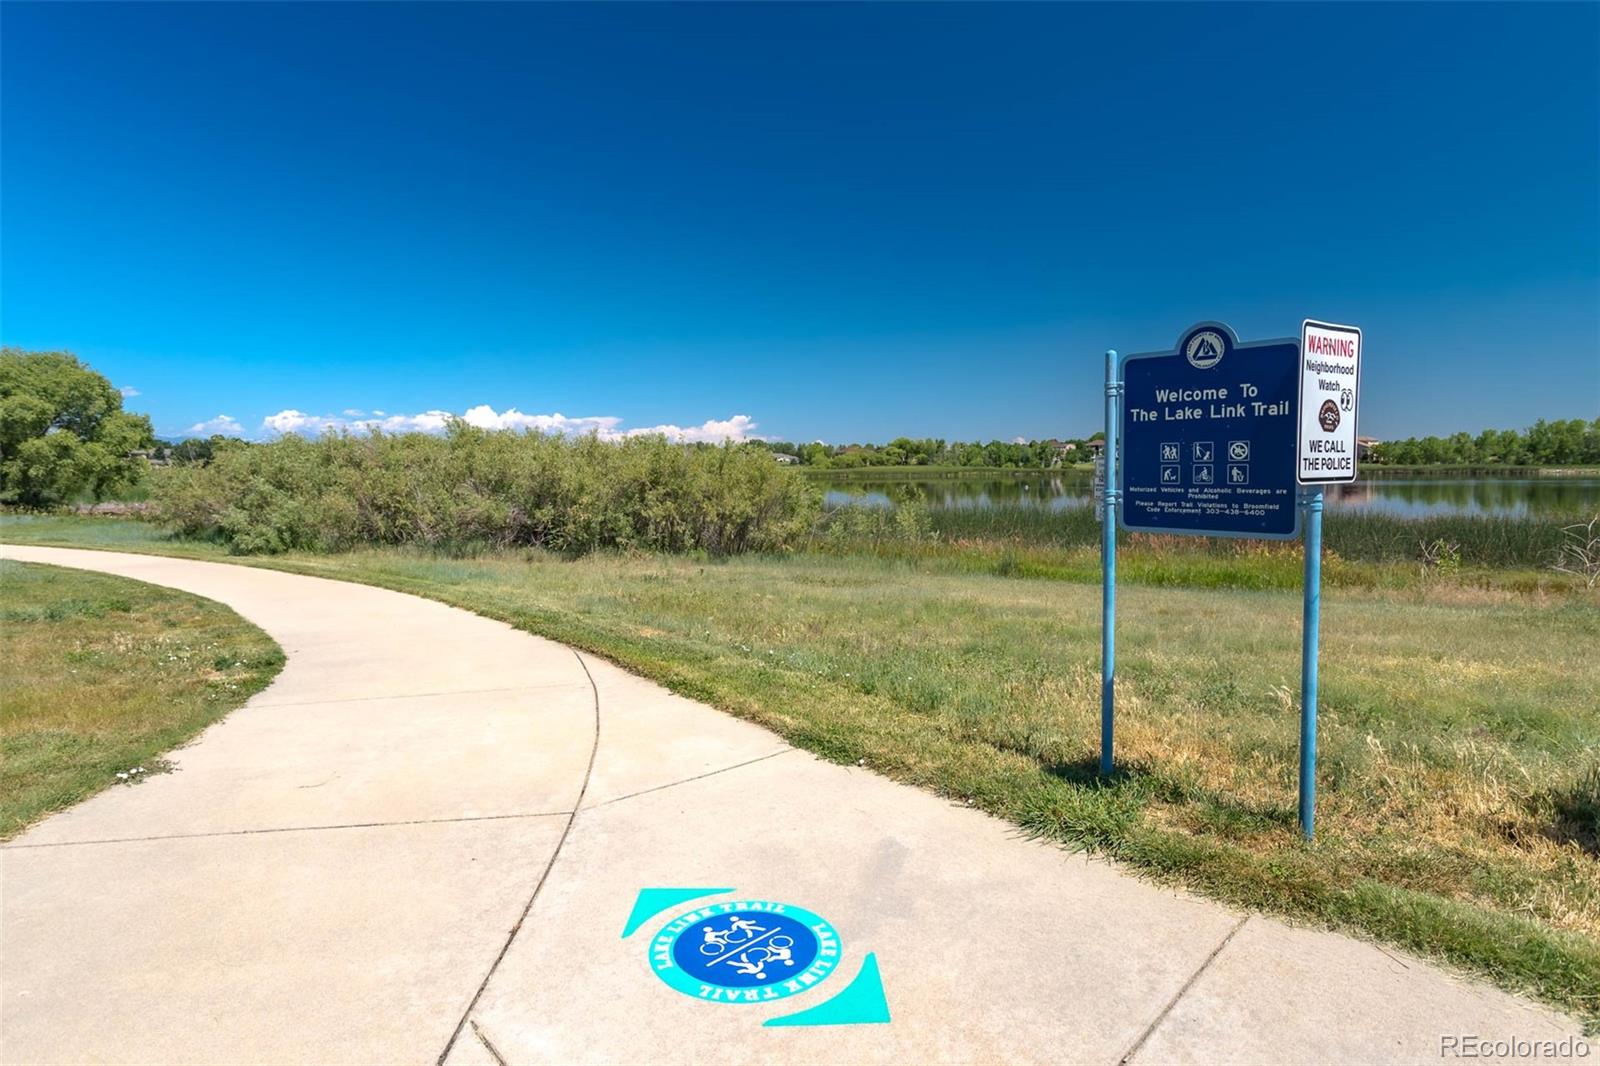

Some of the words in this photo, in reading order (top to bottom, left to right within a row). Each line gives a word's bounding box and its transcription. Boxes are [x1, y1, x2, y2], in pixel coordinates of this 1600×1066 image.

[1308, 334, 1354, 358] WARNING
[1306, 359, 1354, 375] Neighborhood
[1155, 388, 1228, 403] Welcome
[1240, 383, 1258, 398] To
[1318, 378, 1340, 391] Watch
[1131, 409, 1158, 422] The
[1165, 406, 1203, 421] Lake
[1210, 403, 1246, 419] Link
[1251, 400, 1289, 416] Trail
[1309, 440, 1322, 453] WE
[1324, 440, 1346, 453] CALL
[1303, 458, 1320, 471] THE
[1321, 457, 1351, 471] POLICE
[654, 935, 674, 970] LAKE
[666, 908, 716, 934] LINK
[719, 902, 786, 913] TRAIL
[811, 922, 837, 957] LAKE
[783, 960, 832, 993] LINK
[700, 985, 779, 1000] TRAIL
